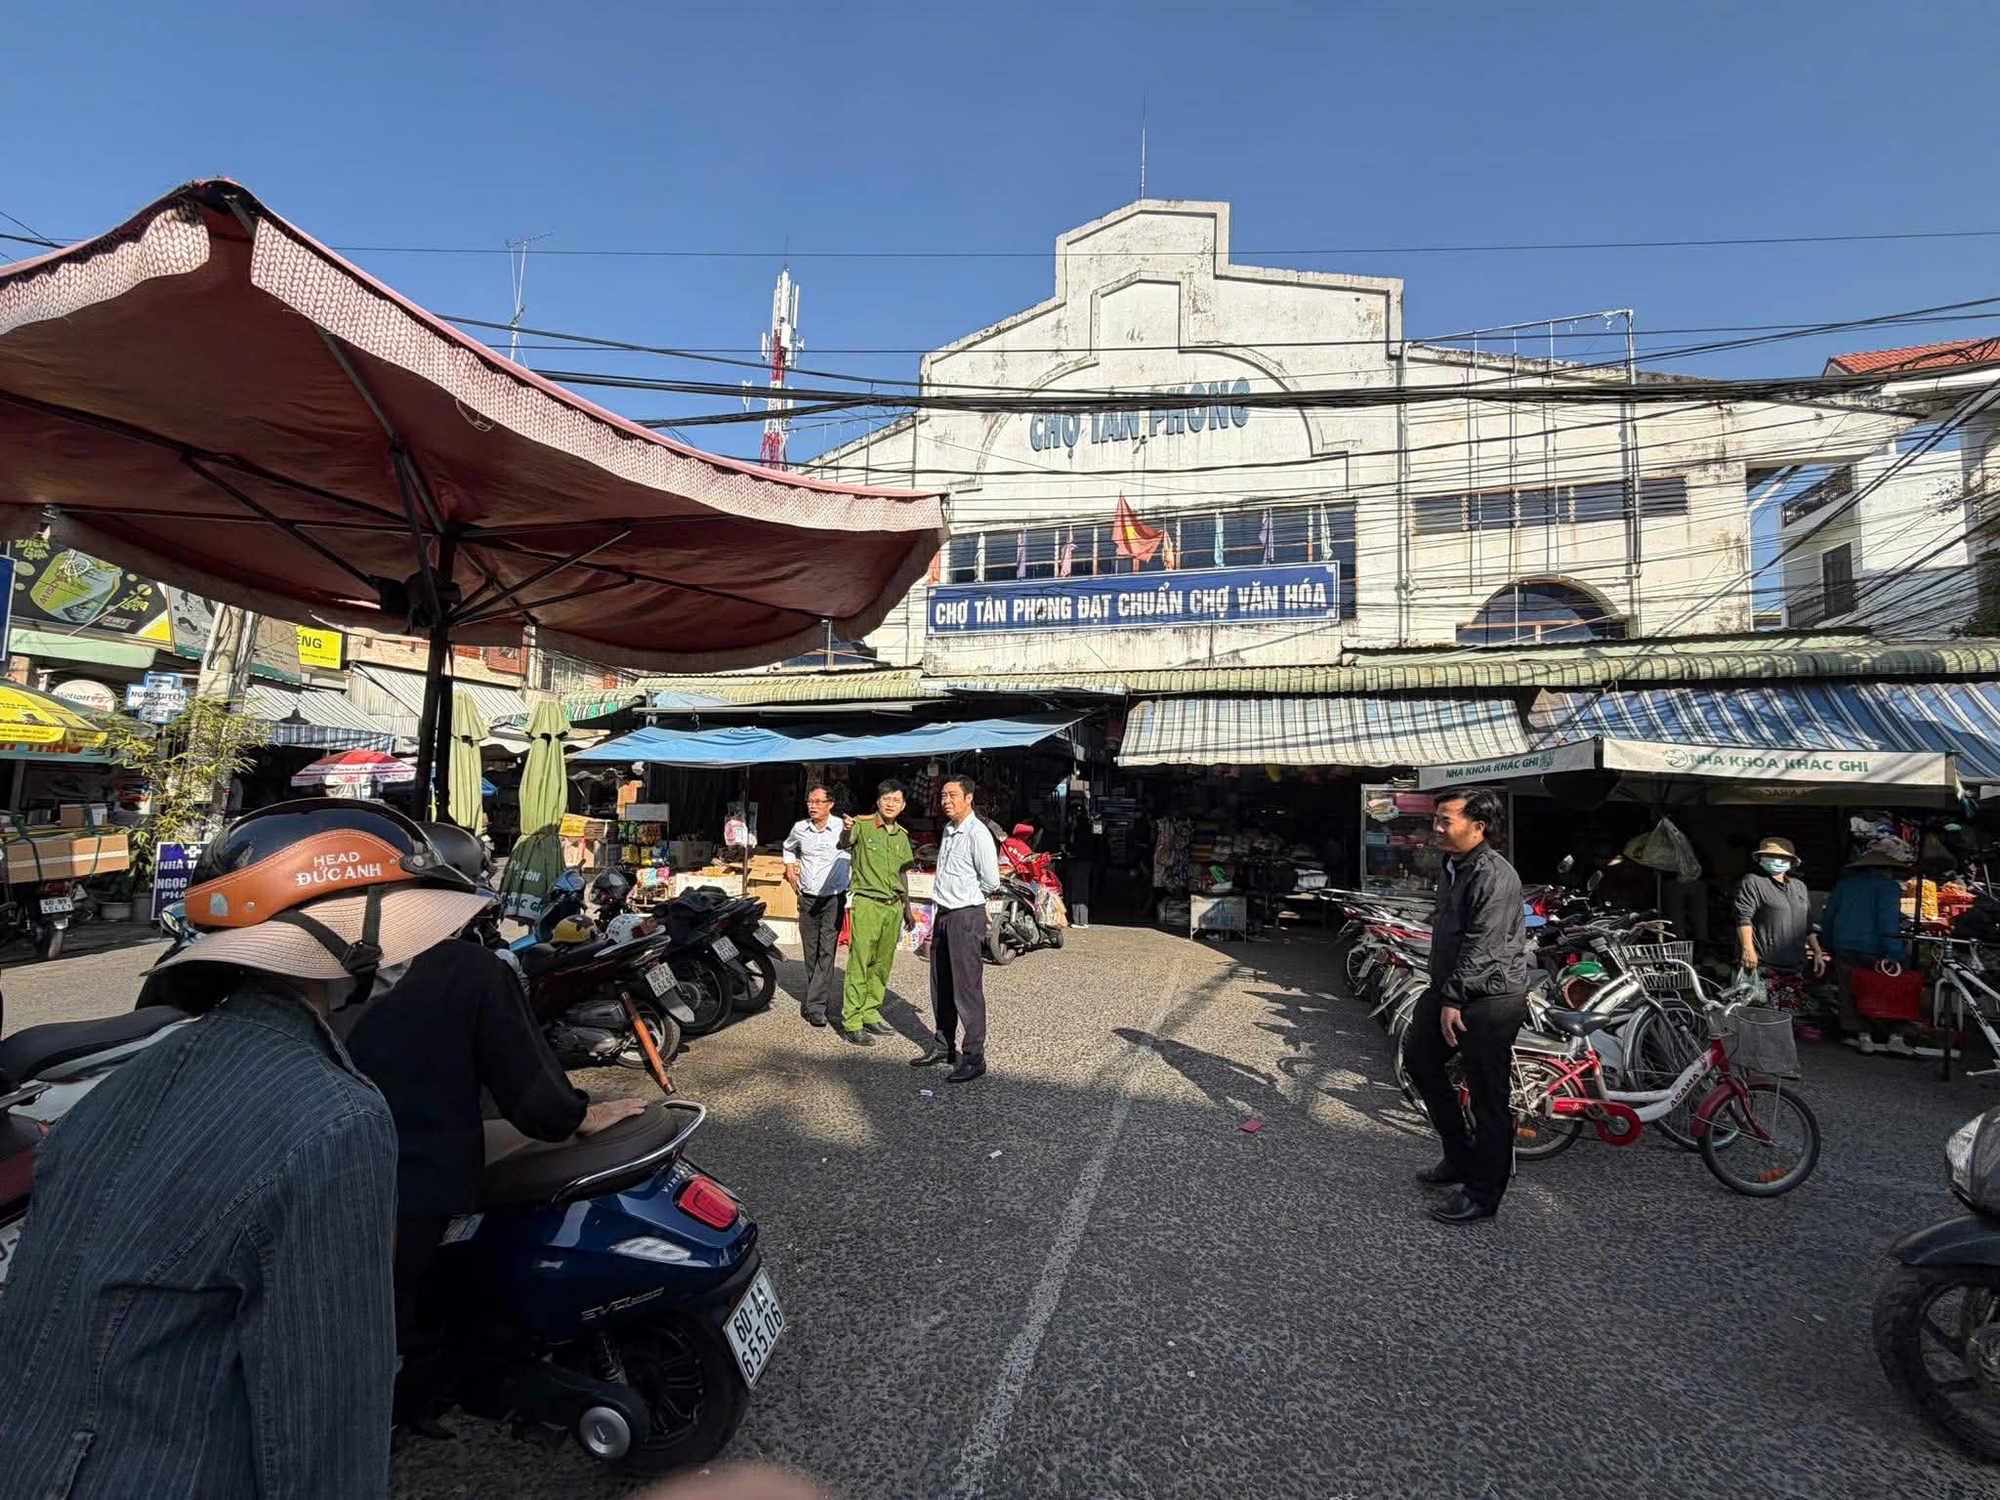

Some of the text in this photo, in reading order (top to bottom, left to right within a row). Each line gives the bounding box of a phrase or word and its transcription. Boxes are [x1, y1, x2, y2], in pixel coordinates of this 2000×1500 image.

[1149, 377, 1251, 437] PHONG
[935, 578, 1327, 630] CHỢ TÂN PHONG ĐẠT CHUẨN CHỢ VĂN HÓA
[1522, 757, 1540, 768] GHI
[1690, 754, 1724, 766] NHA
[1729, 756, 1779, 769] KHOA
[1839, 760, 1869, 772] GHI
[313, 851, 361, 867] HEAD
[295, 863, 383, 887] ĐỨC ANH
[1669, 1072, 1700, 1110] ASAMA
[741, 1302, 783, 1379] 655.06
